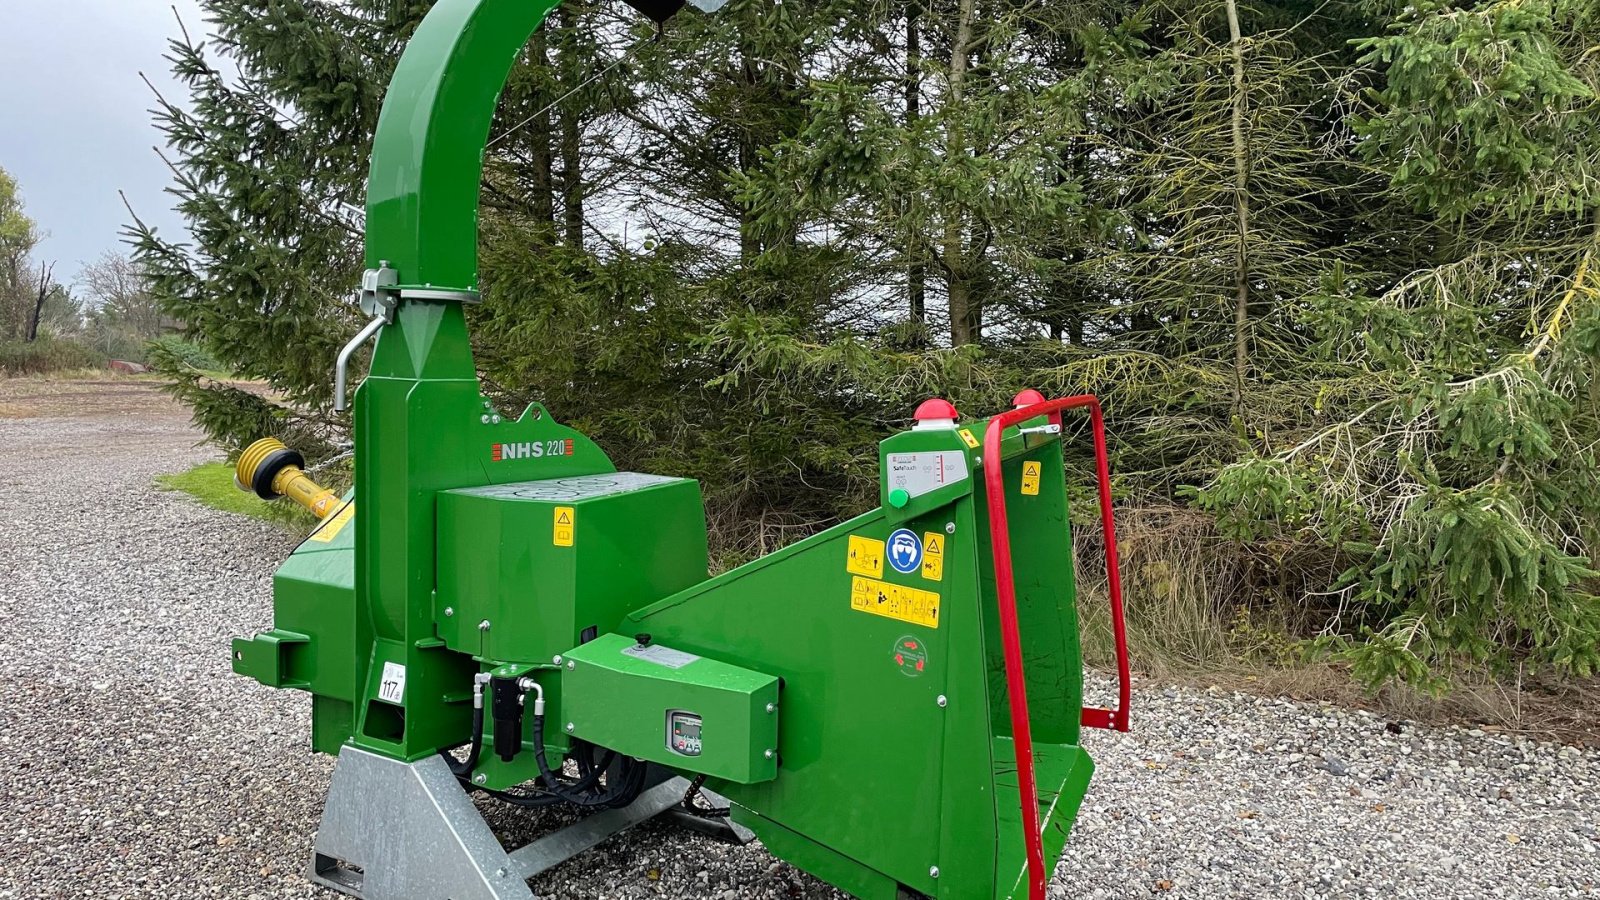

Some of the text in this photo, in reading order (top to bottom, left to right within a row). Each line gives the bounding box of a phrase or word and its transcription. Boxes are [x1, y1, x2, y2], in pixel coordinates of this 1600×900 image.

[502, 440, 565, 459] NHS 220
[383, 680, 398, 698] 117
